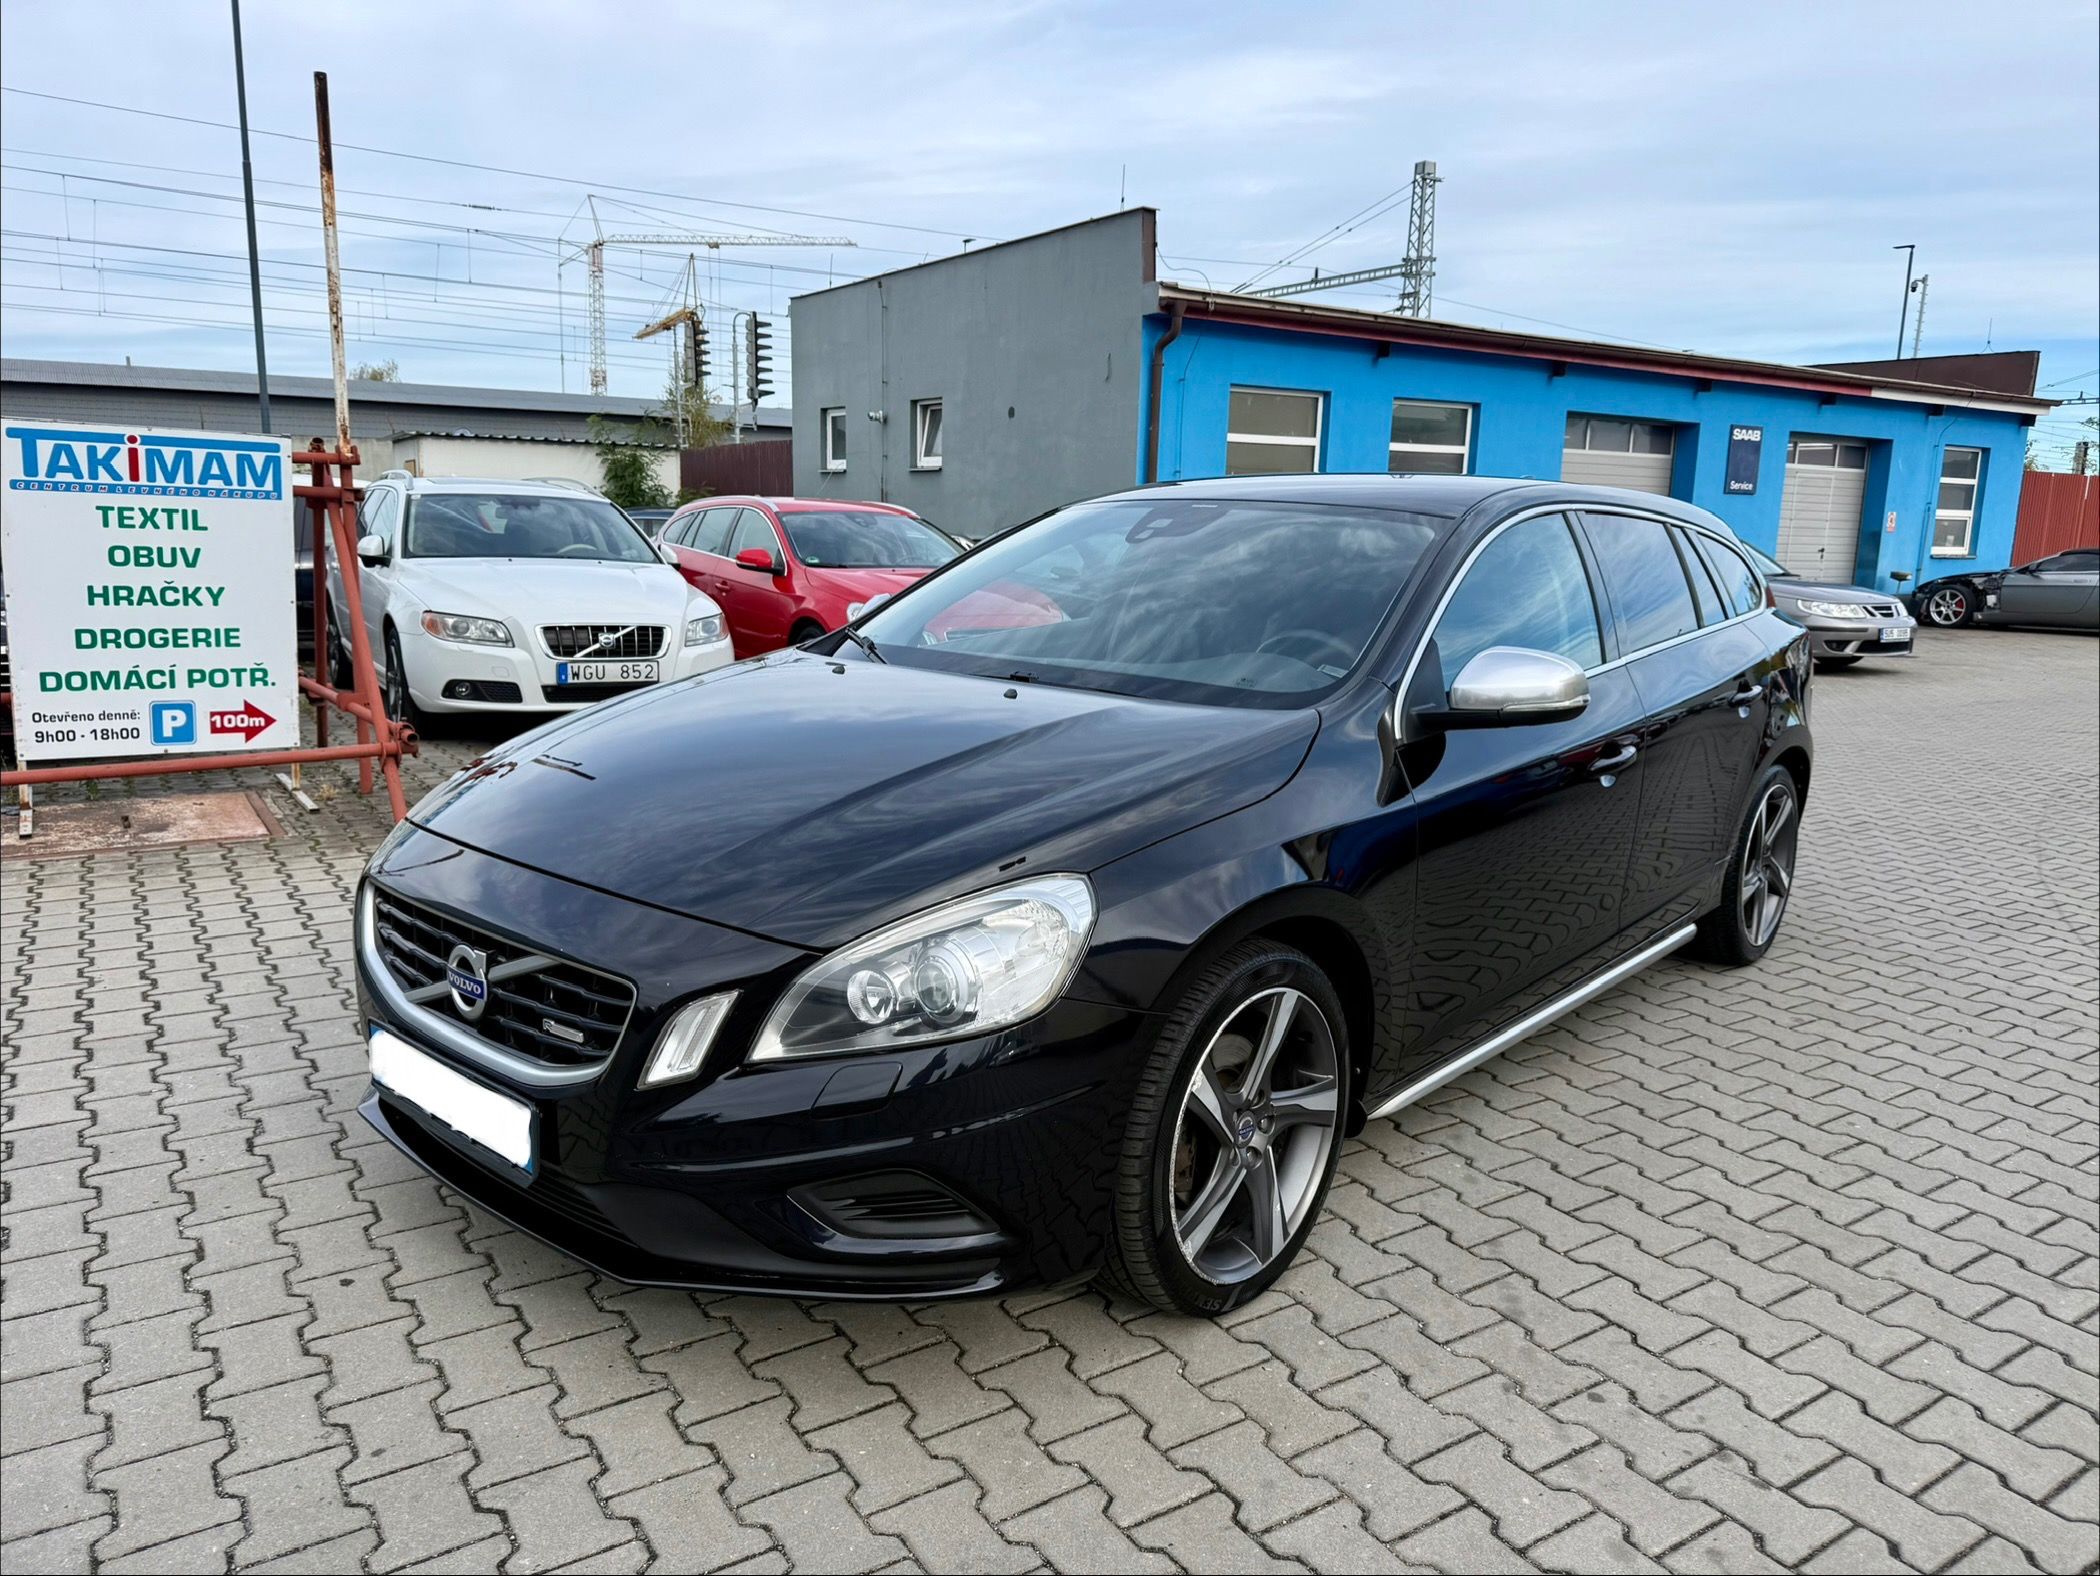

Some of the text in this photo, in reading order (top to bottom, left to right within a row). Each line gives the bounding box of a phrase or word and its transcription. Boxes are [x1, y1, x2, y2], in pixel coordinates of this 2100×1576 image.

[1733, 428, 1761, 441] SAAB
[16, 481, 278, 499] CENTRUM LEVNÉHO NÁKUPU
[1730, 481, 1753, 490] Service
[96, 505, 208, 531] TEXTIL
[108, 545, 201, 568] OBUV
[87, 580, 225, 607] HRAČKY
[74, 627, 241, 650] DROGERIE
[39, 662, 276, 692] DOMÁCÍ POTŘ.
[570, 664, 654, 680] WGU 852
[32, 709, 140, 724] Otevřeno denně:
[161, 709, 187, 737] P
[210, 713, 265, 728] 100m
[34, 730, 76, 743] 9h00
[90, 727, 140, 741] 18h00
[448, 971, 482, 995] VOLVO
